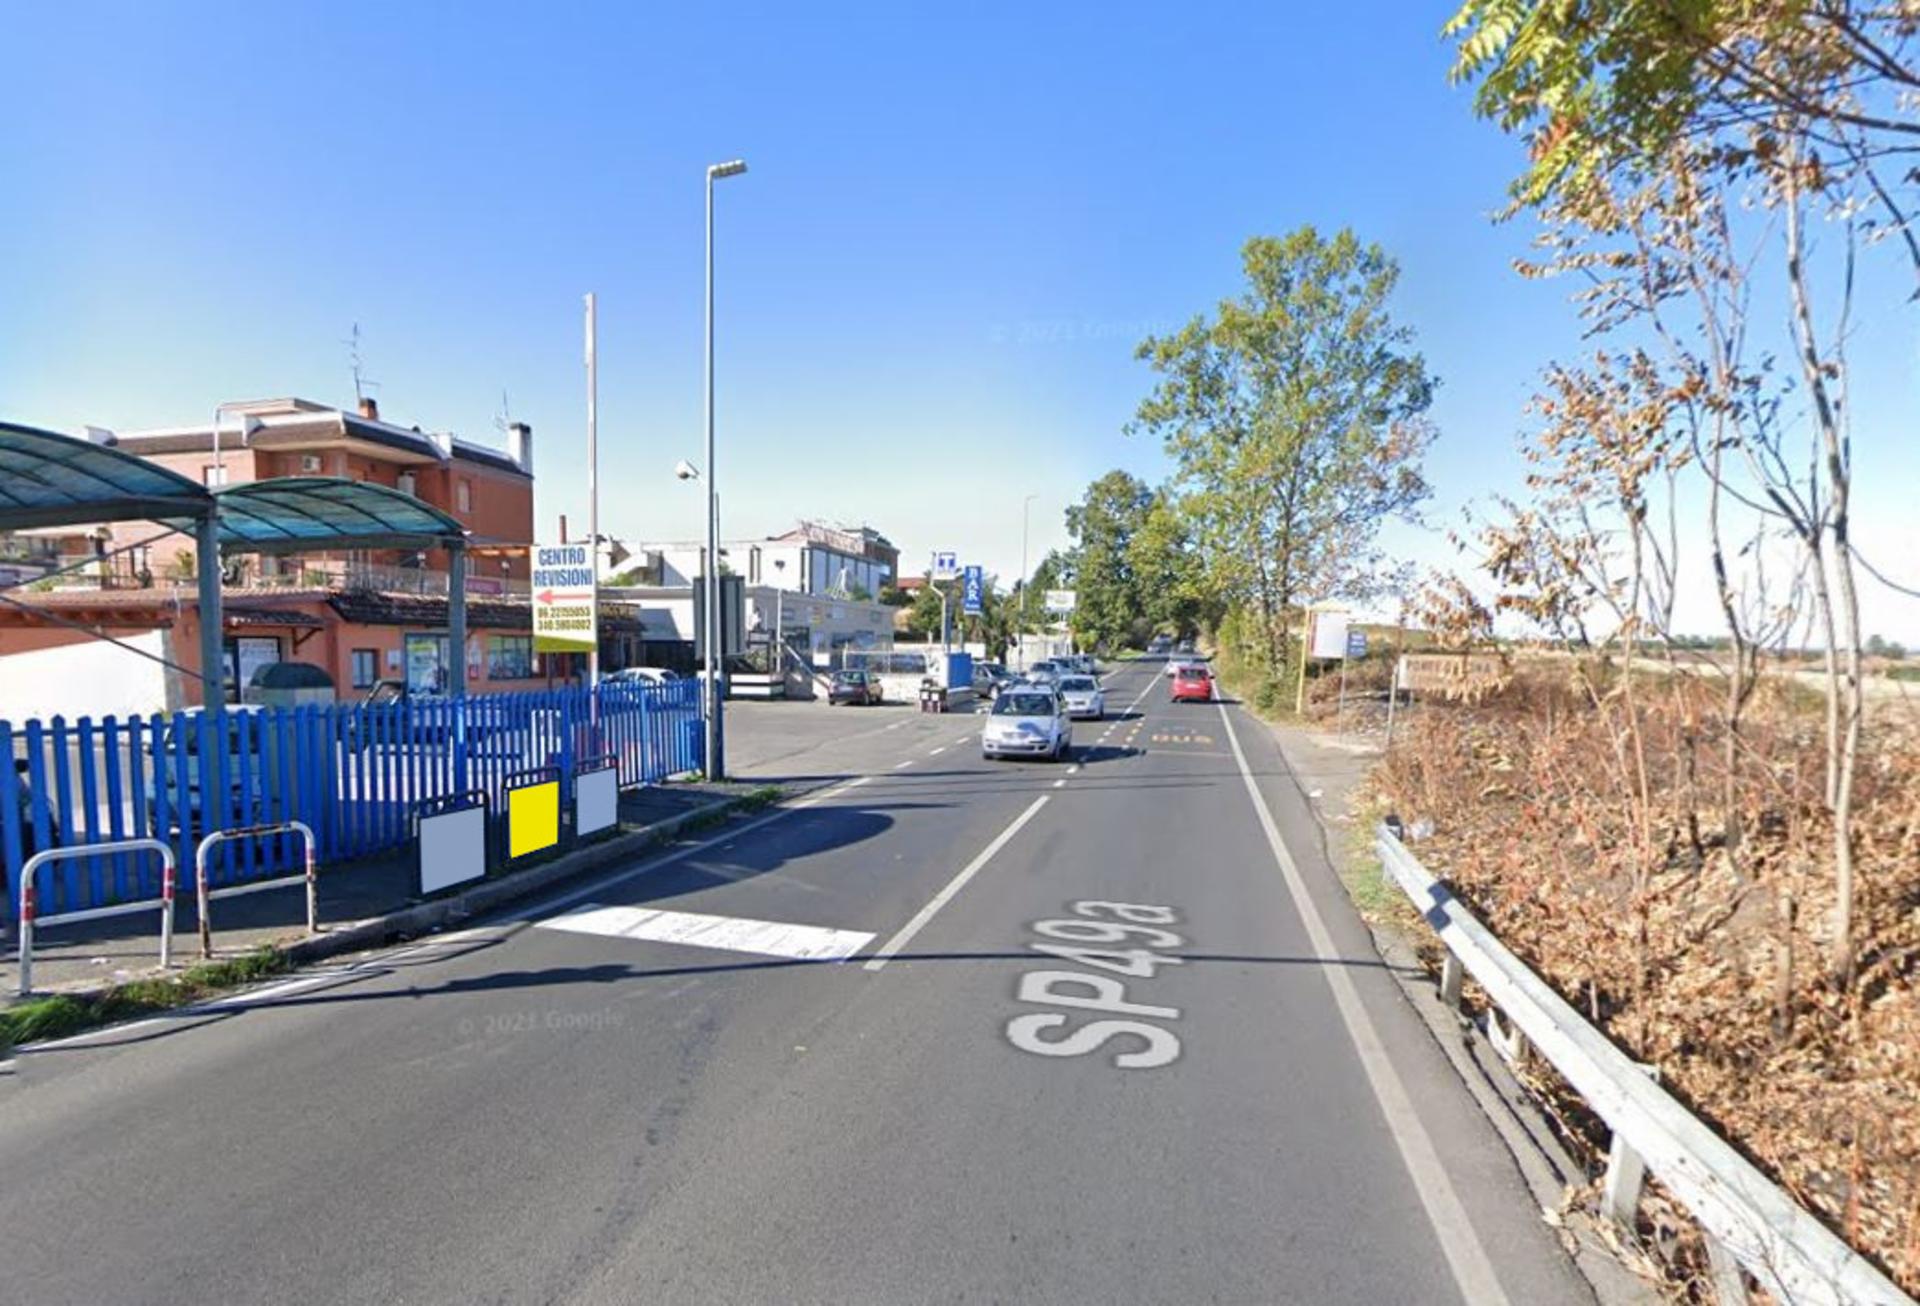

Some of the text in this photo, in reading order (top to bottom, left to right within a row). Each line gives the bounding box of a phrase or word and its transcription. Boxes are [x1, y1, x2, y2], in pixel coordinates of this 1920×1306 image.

[538, 547, 585, 566] CENTRO
[534, 569, 592, 587] REVISIONI
[967, 567, 980, 601] BAR
[1152, 734, 1213, 744] BUS
